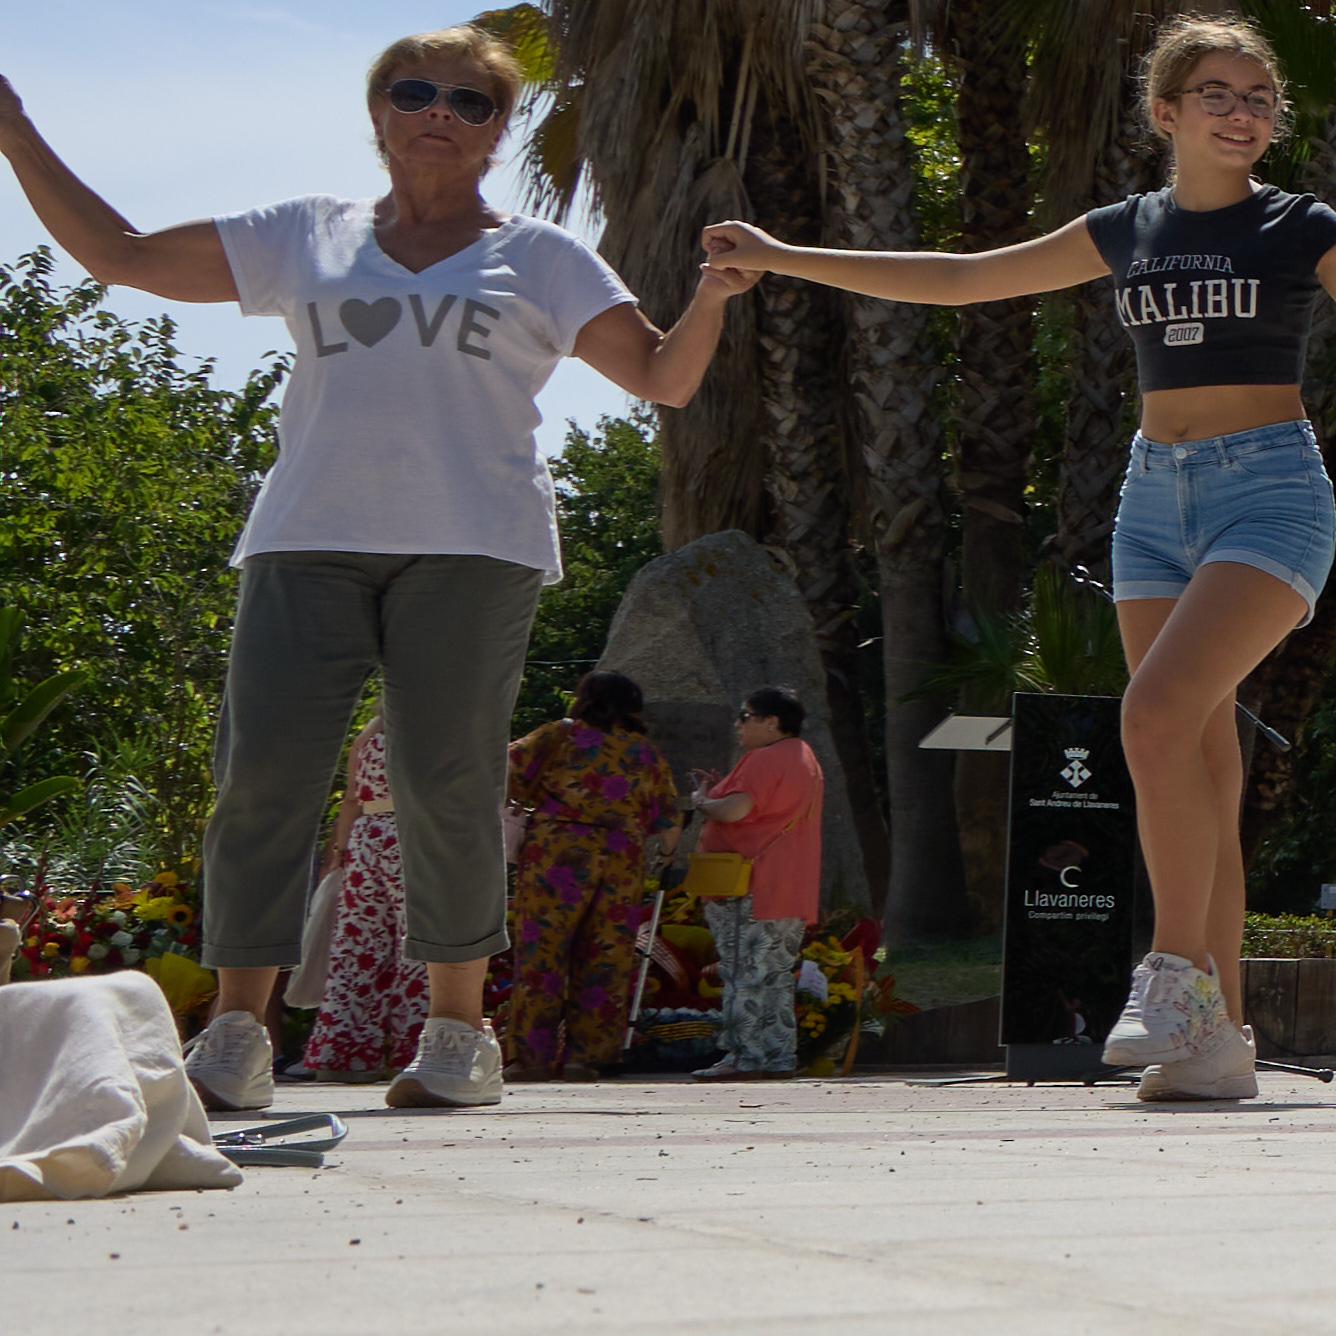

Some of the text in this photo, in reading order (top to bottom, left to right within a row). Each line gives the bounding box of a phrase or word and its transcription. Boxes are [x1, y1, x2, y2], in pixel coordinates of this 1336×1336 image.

[1127, 254, 1235, 279] CALIFORNIA
[1115, 278, 1260, 327] MALIBU
[1168, 326, 1200, 343] 2007
[1029, 798, 1119, 810] Sant Andreu de Llavaneres
[1051, 791, 1099, 800] Ajuntament de
[1024, 889, 1115, 909] Llavaneres
[1028, 910, 1074, 921] Compartim
